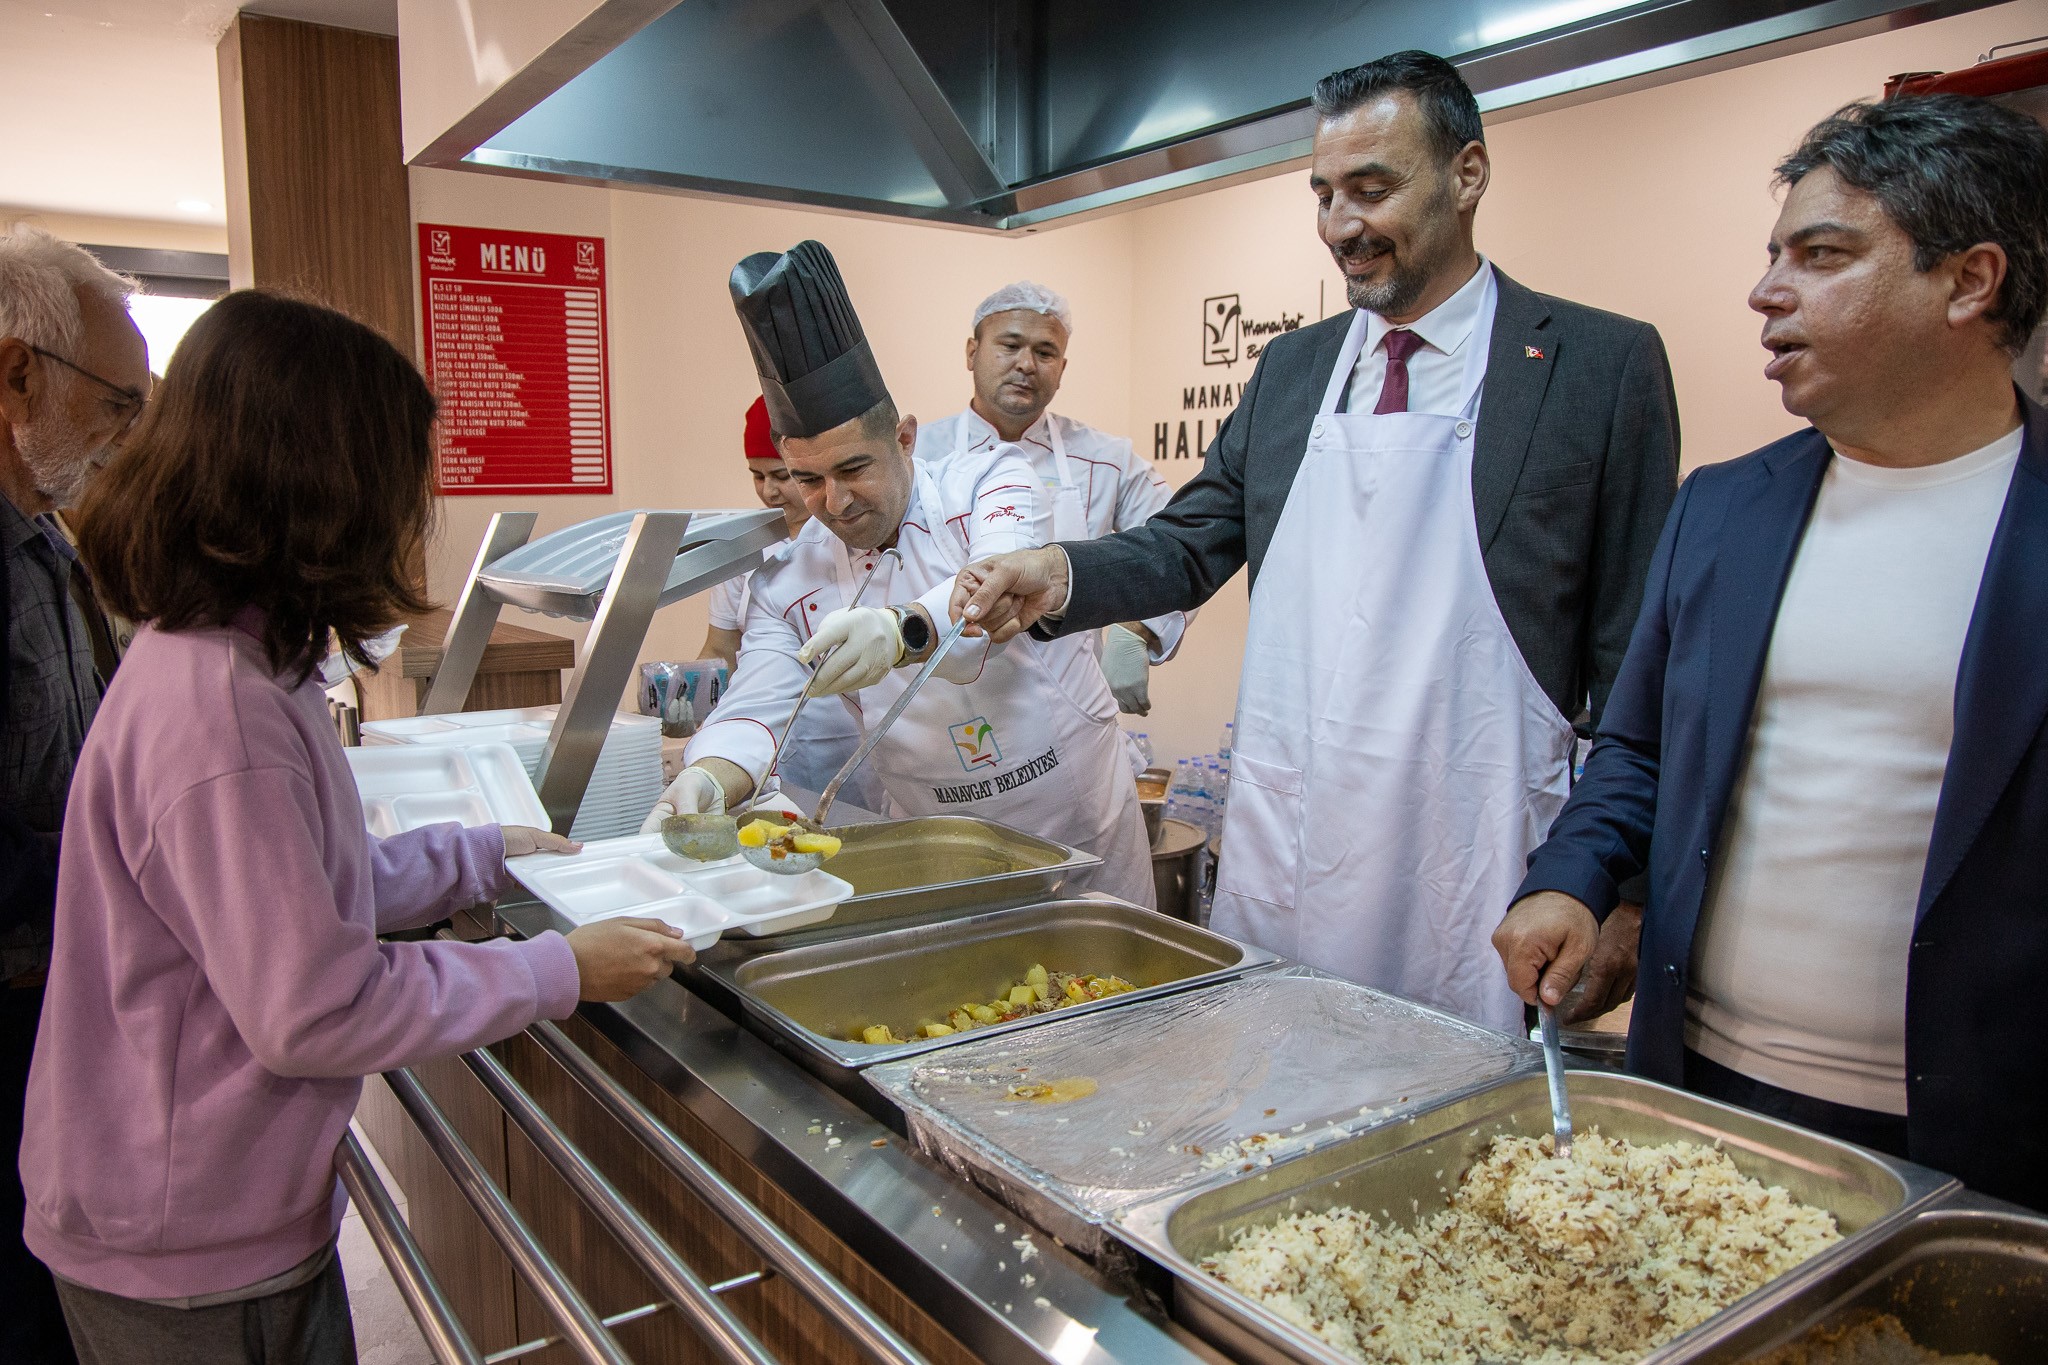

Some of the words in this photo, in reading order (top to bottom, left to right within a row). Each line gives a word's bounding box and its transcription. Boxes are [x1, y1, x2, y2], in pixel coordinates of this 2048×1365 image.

[480, 243, 546, 273] MENÜ
[434, 293, 457, 301] KIZILAY
[476, 295, 492, 303] SODA
[487, 305, 503, 313] SODA
[484, 324, 501, 332] SODA
[456, 409, 467, 417] TEA
[932, 780, 992, 803] MANAVGAT
[994, 746, 1059, 793] BELEDİYESİ
